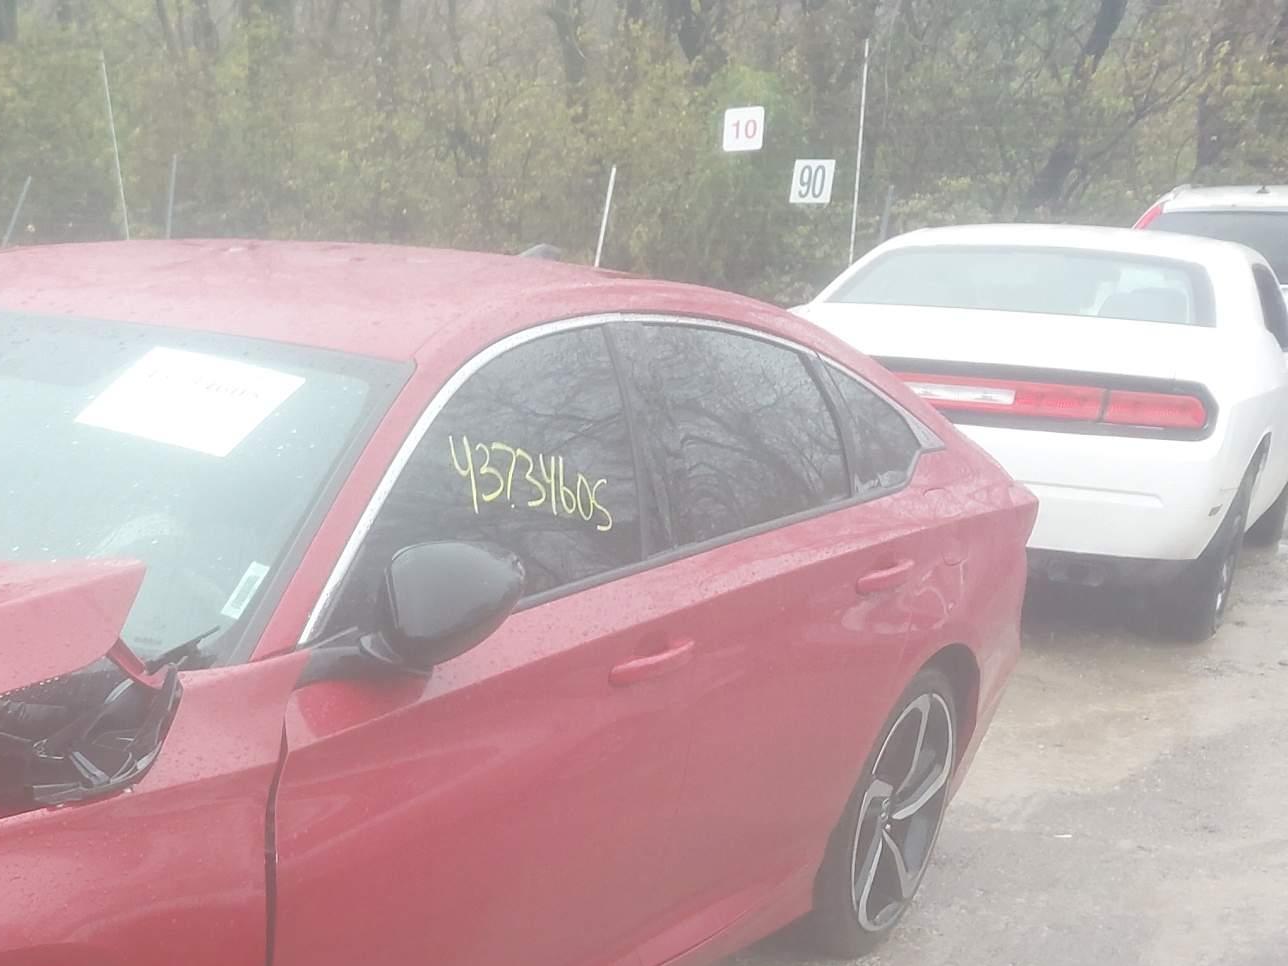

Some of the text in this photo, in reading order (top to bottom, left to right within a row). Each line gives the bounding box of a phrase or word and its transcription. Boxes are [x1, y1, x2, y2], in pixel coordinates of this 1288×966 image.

[731, 119, 758, 140] 10
[798, 165, 826, 199] 90
[448, 434, 613, 532] 43734605
